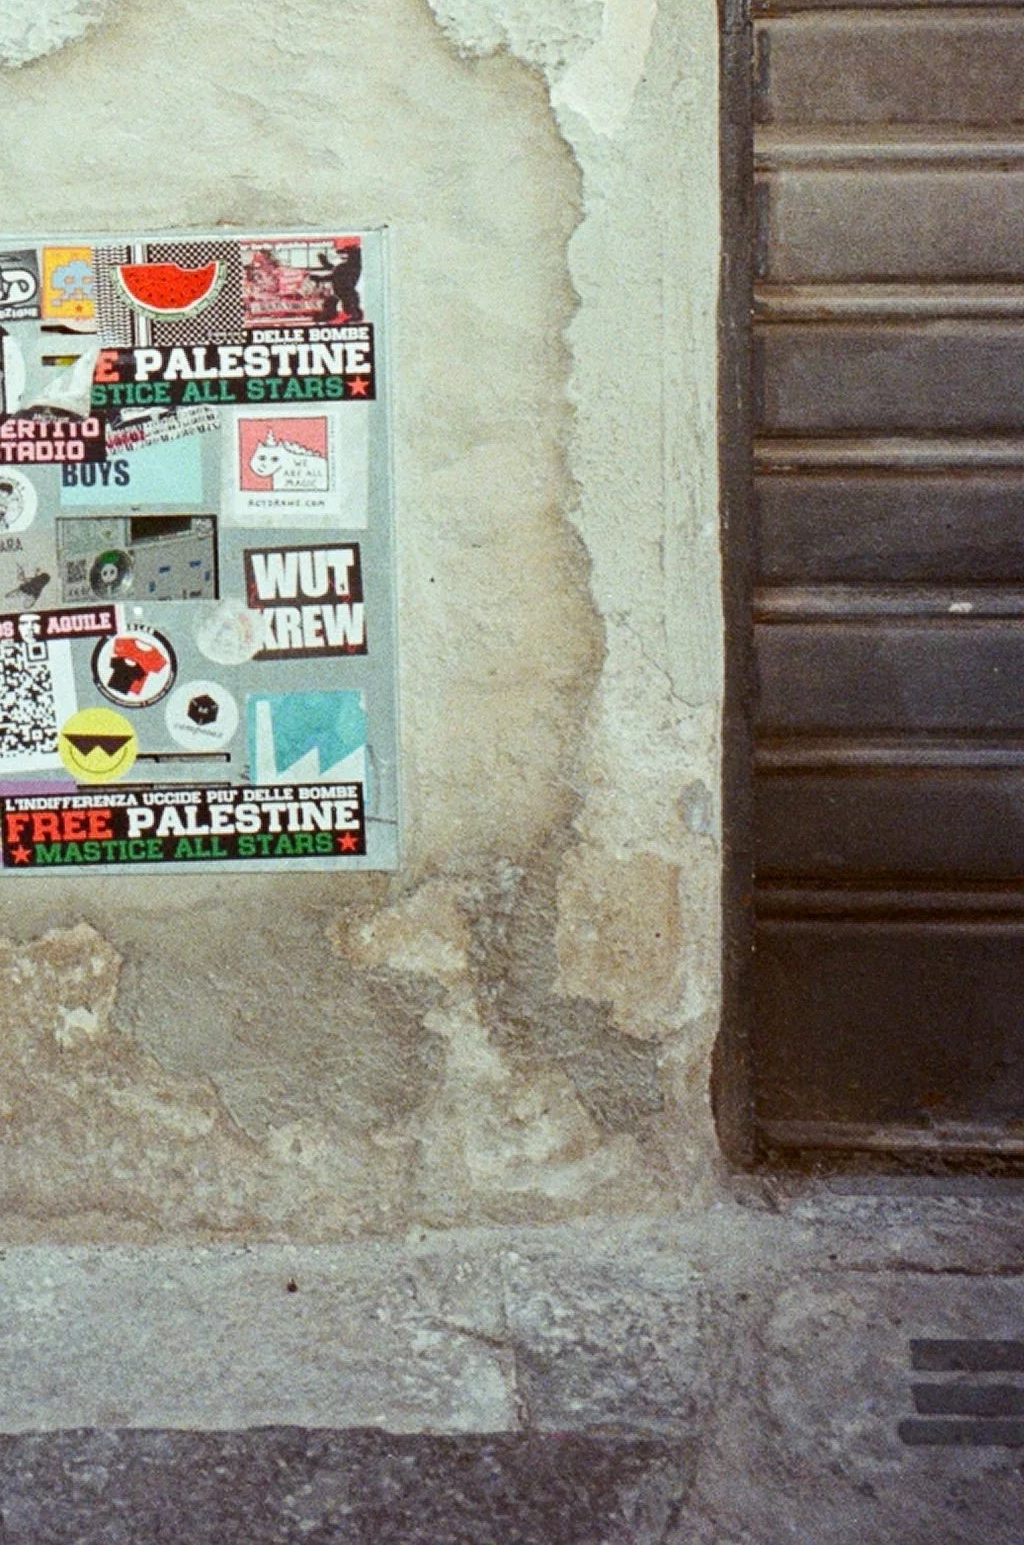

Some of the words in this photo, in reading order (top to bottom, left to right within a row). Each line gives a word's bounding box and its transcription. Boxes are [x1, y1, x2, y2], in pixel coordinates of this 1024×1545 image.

[252, 329, 304, 344] DELLE
[309, 327, 369, 342] BOMBE
[133, 342, 372, 381] PALESTINE
[91, 381, 172, 405] STICE
[181, 378, 236, 402] ALL
[247, 375, 343, 399] STARS
[62, 459, 130, 487] BOYS
[251, 548, 355, 600] WUT
[46, 612, 112, 634] AQUILE
[5, 793, 138, 812] L'INDIFFERENZA
[142, 791, 202, 805] UCCIDE
[243, 788, 293, 802] DELLE
[298, 785, 358, 799] BOMBE
[6, 809, 113, 843] FREE
[127, 800, 360, 838] PALESTINE
[35, 837, 163, 863] MASTICE
[175, 835, 228, 858] ALL
[238, 832, 333, 855] STARS
